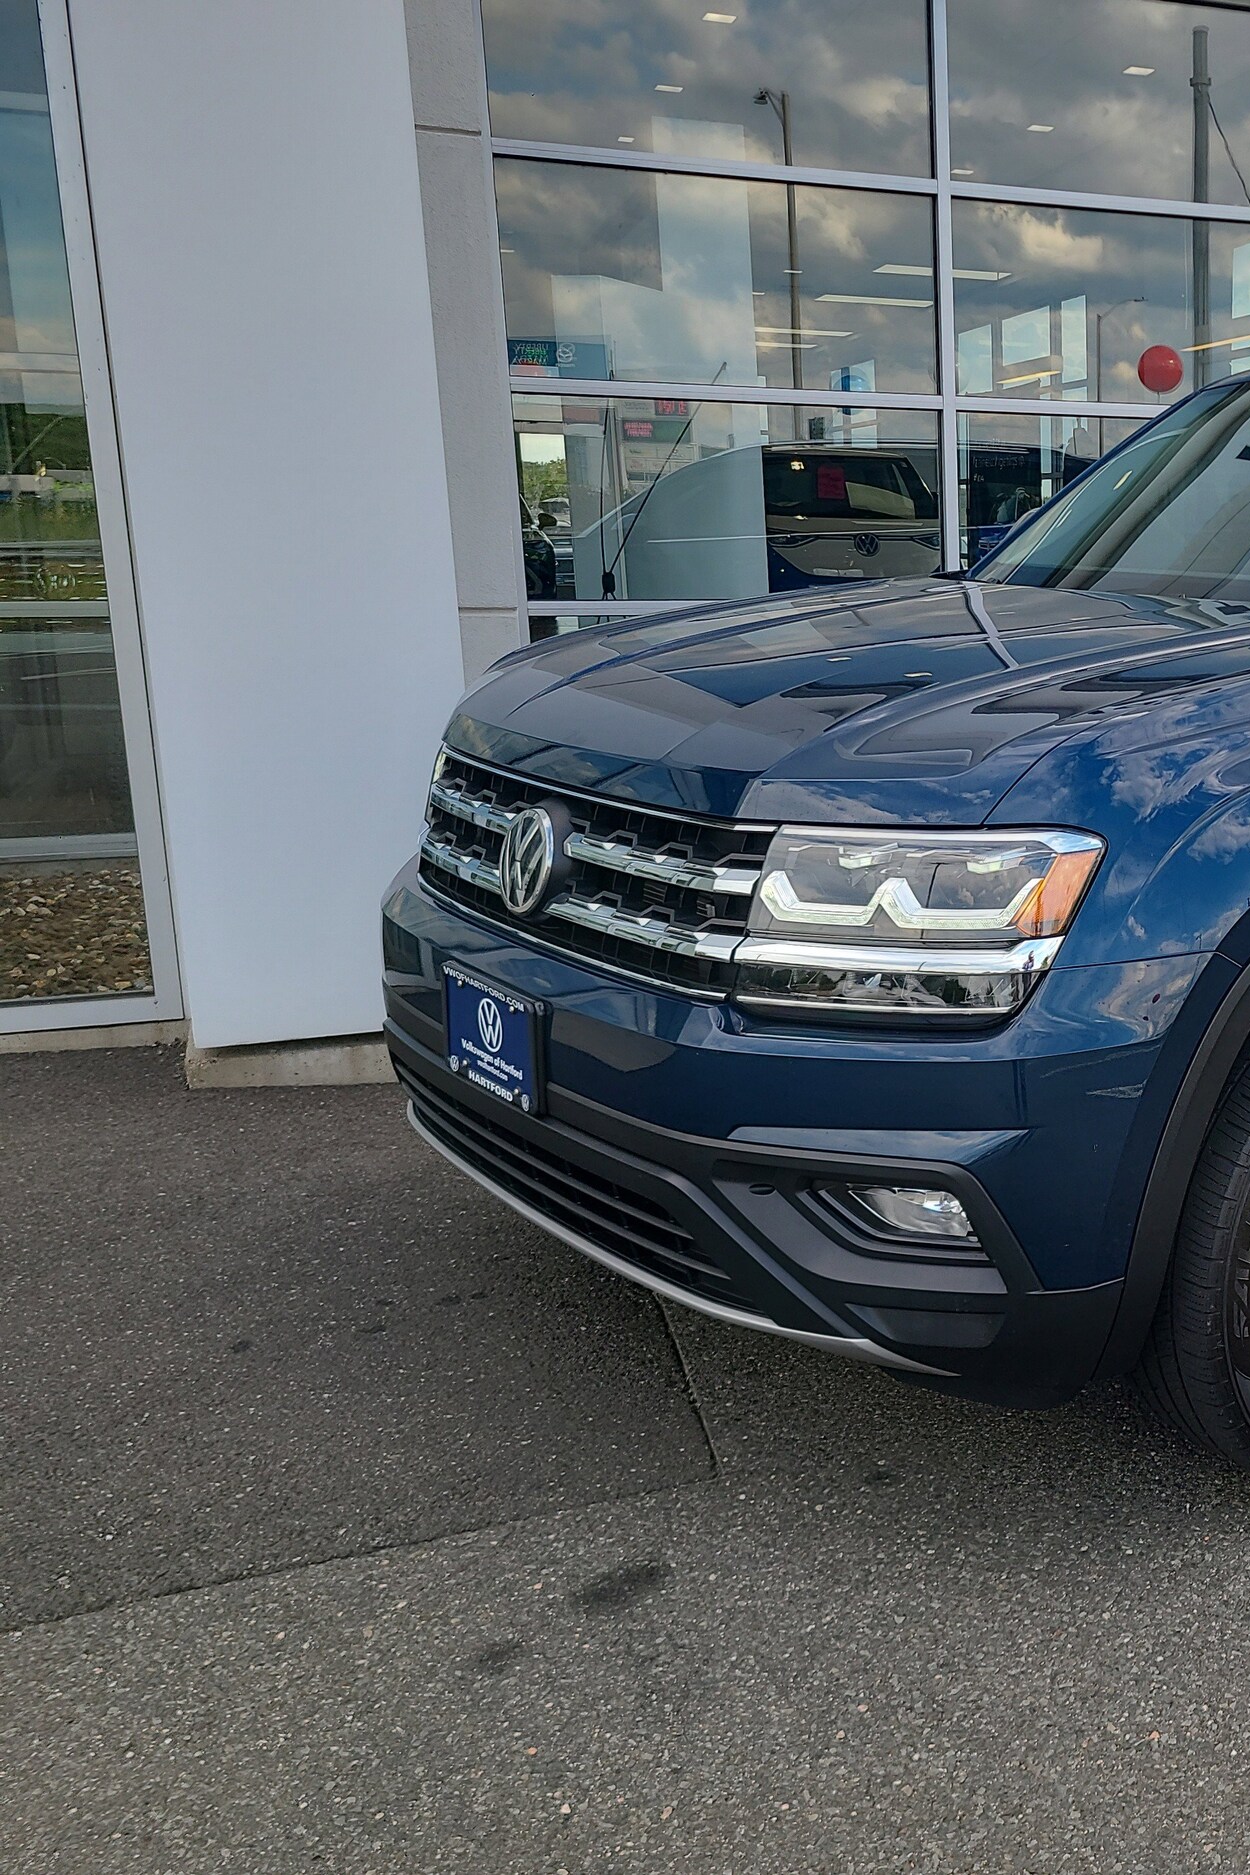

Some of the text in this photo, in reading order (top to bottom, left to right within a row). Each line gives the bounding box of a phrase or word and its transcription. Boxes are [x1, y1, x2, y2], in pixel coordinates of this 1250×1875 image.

[478, 997, 503, 1053] VW
[461, 1038, 523, 1081] Volkswagen of Hartford
[468, 1069, 514, 1103] HARTFORD
